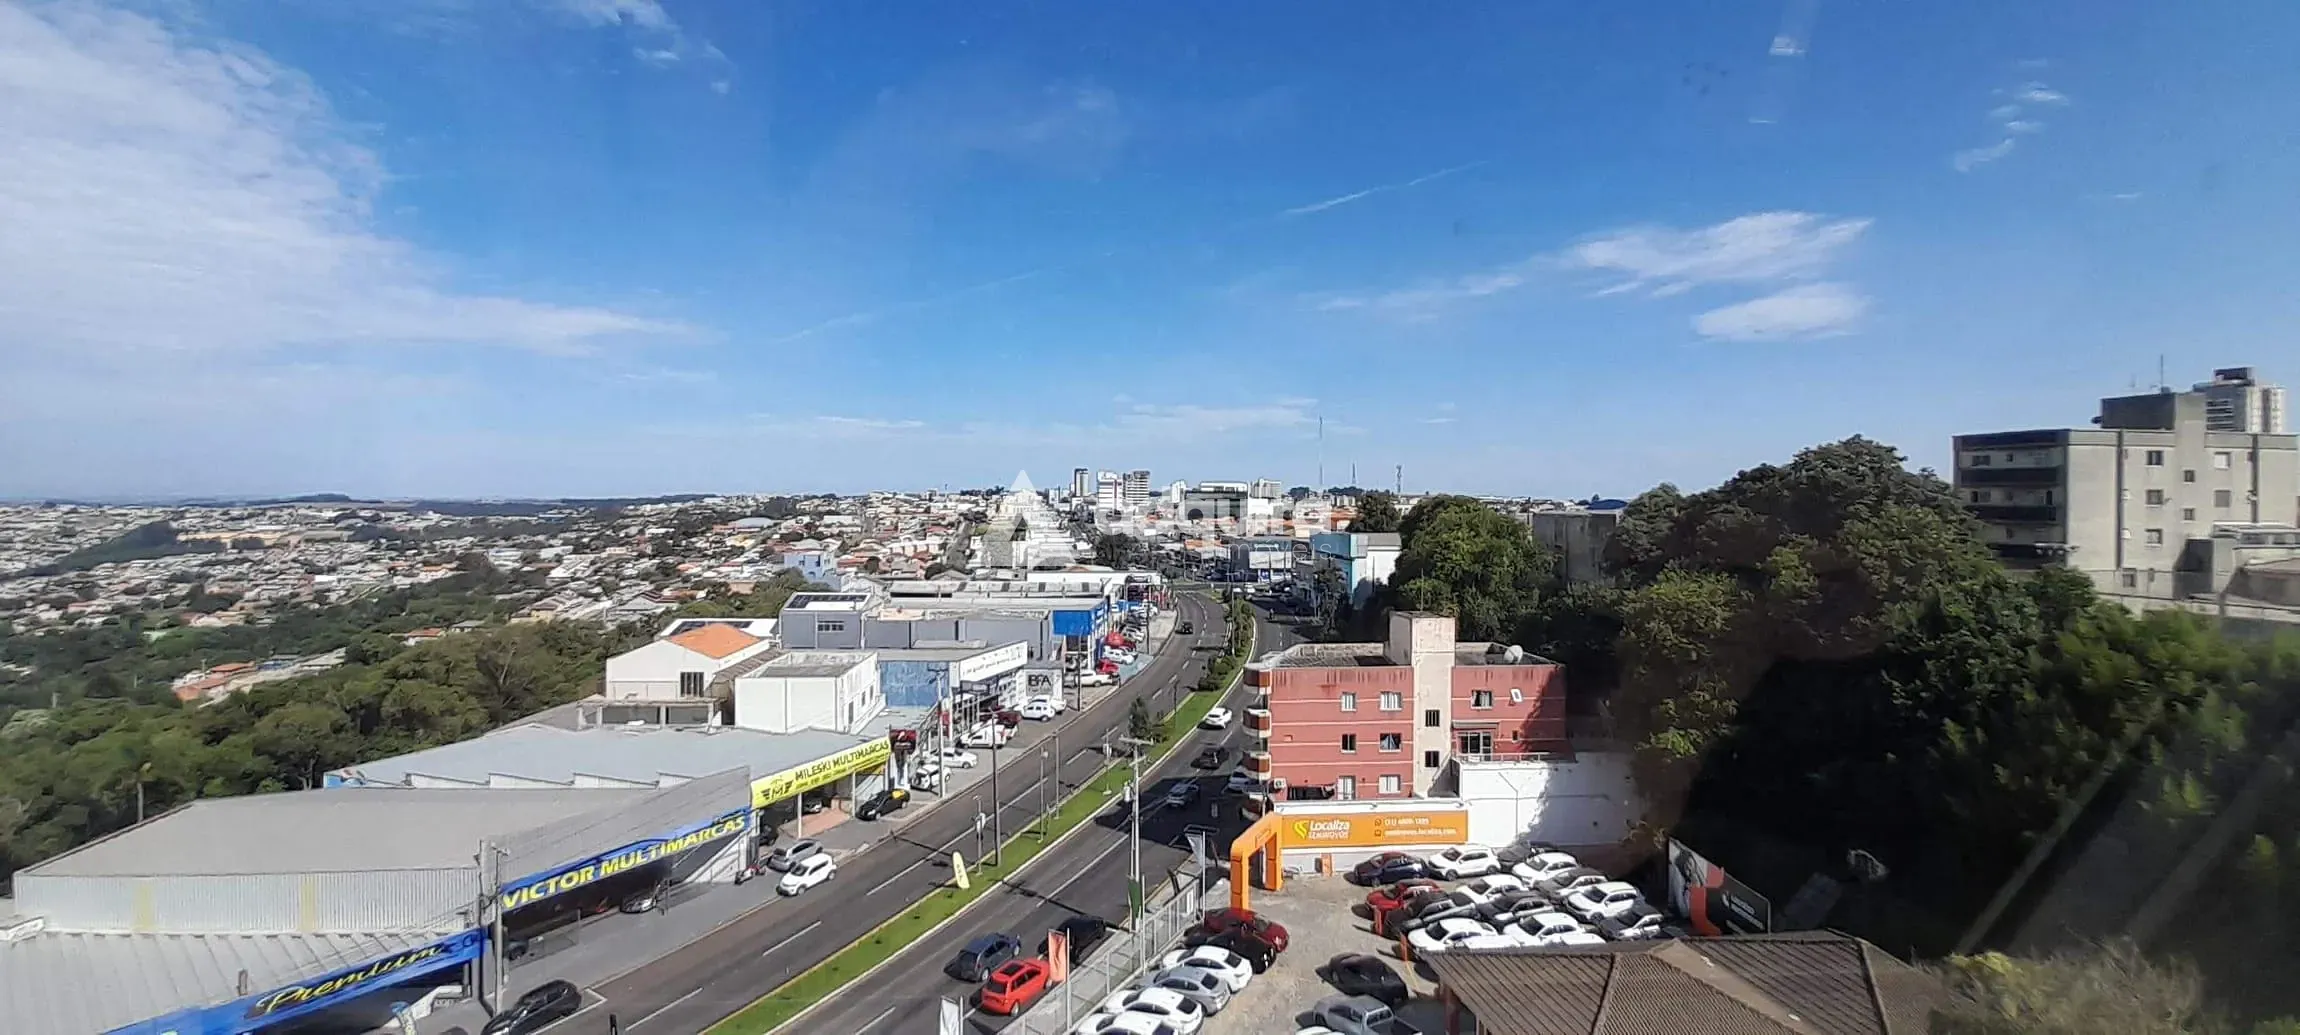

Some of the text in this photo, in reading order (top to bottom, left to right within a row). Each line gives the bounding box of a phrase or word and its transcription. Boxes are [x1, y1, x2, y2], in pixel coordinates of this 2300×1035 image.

[795, 760, 831, 781] MILESKI
[833, 740, 889, 768] MULTIMARCAS
[1310, 819, 1350, 831] Localiza
[502, 815, 746, 909] VICTOR MULTIMARCAS
[255, 946, 443, 1015] Premium
